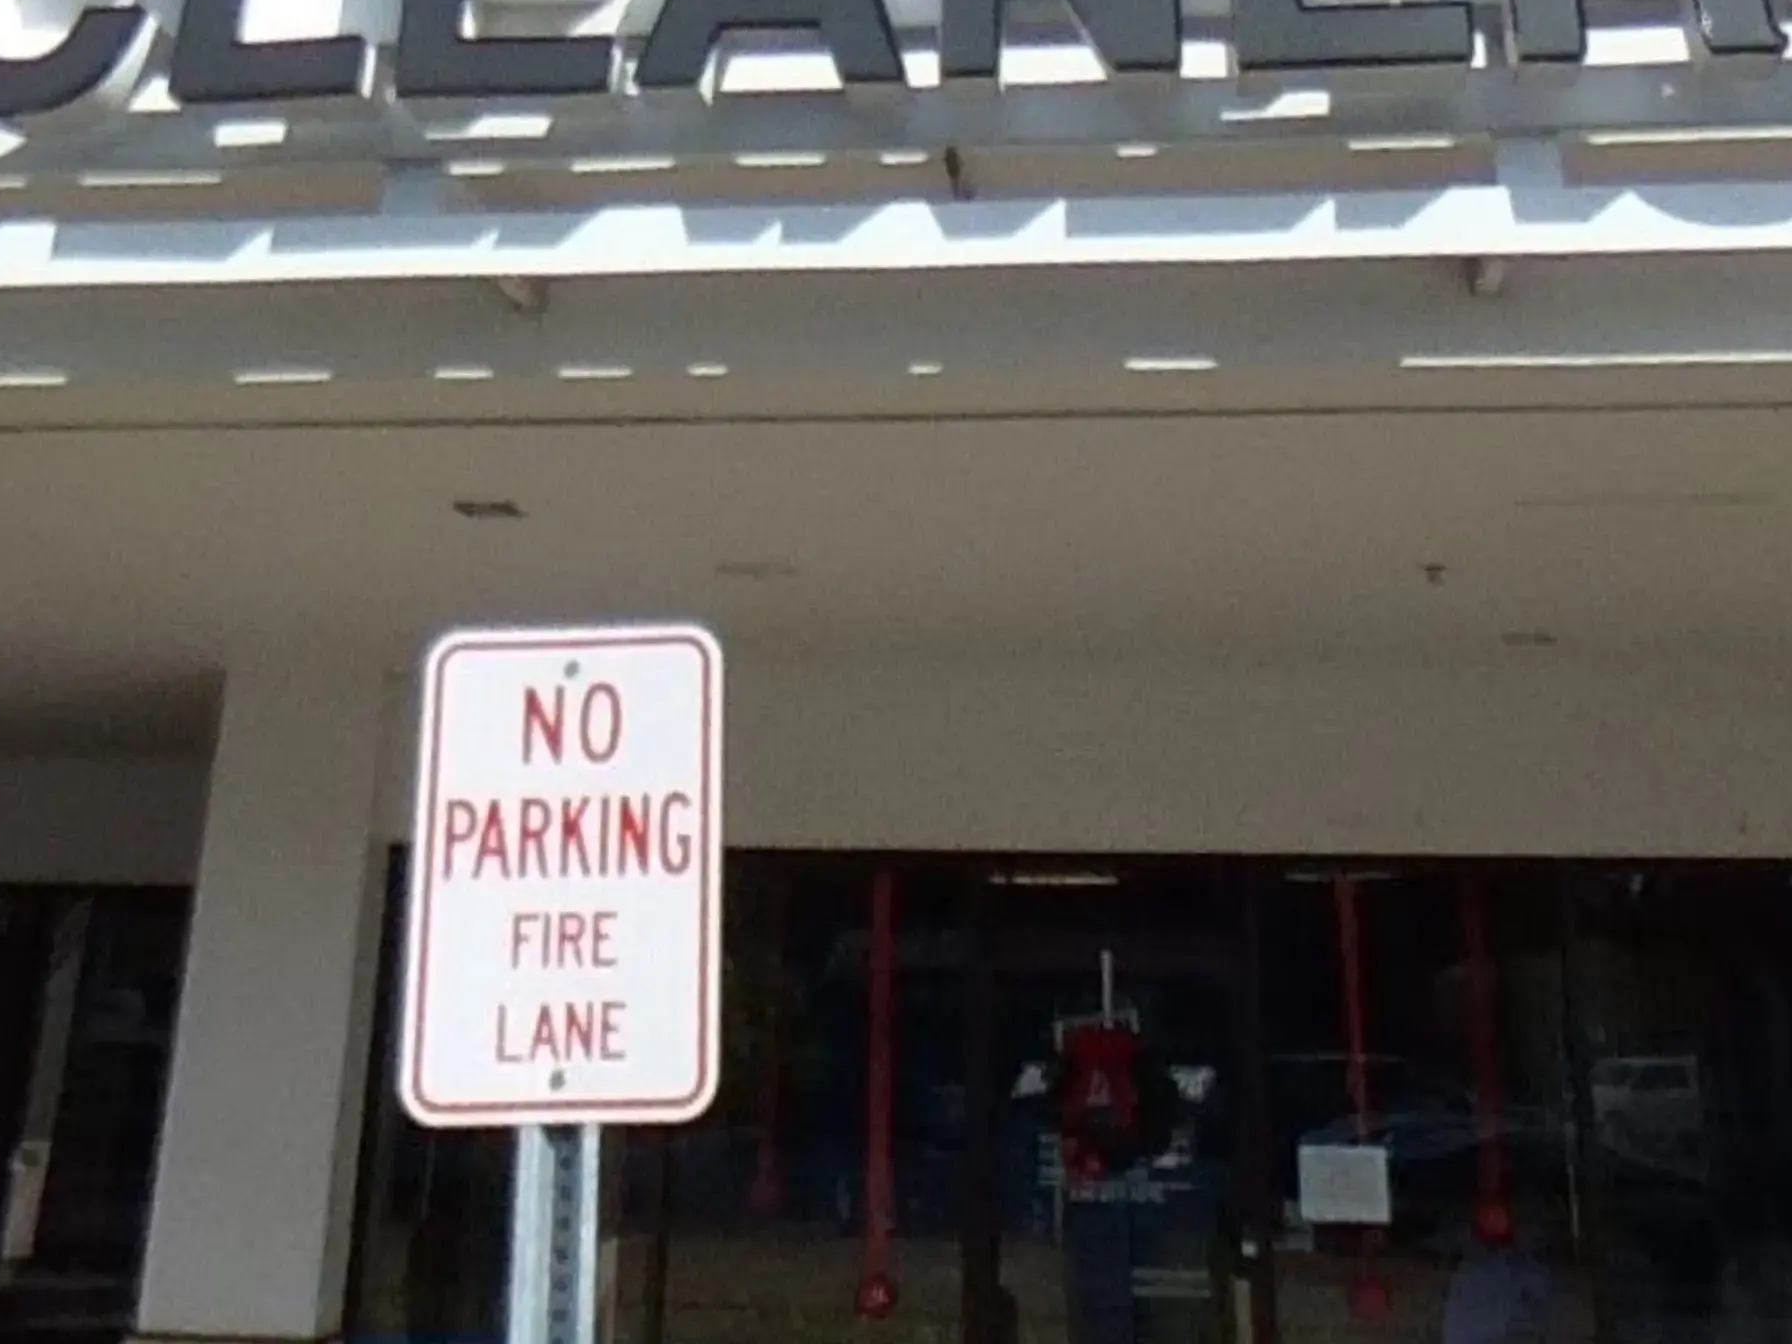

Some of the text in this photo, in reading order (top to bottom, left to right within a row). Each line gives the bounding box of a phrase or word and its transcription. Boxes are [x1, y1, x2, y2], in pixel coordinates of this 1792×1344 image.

[521, 682, 623, 765] NO
[441, 791, 692, 881] PARKING
[510, 911, 619, 969] FIRE
[495, 1001, 628, 1063] LANE
